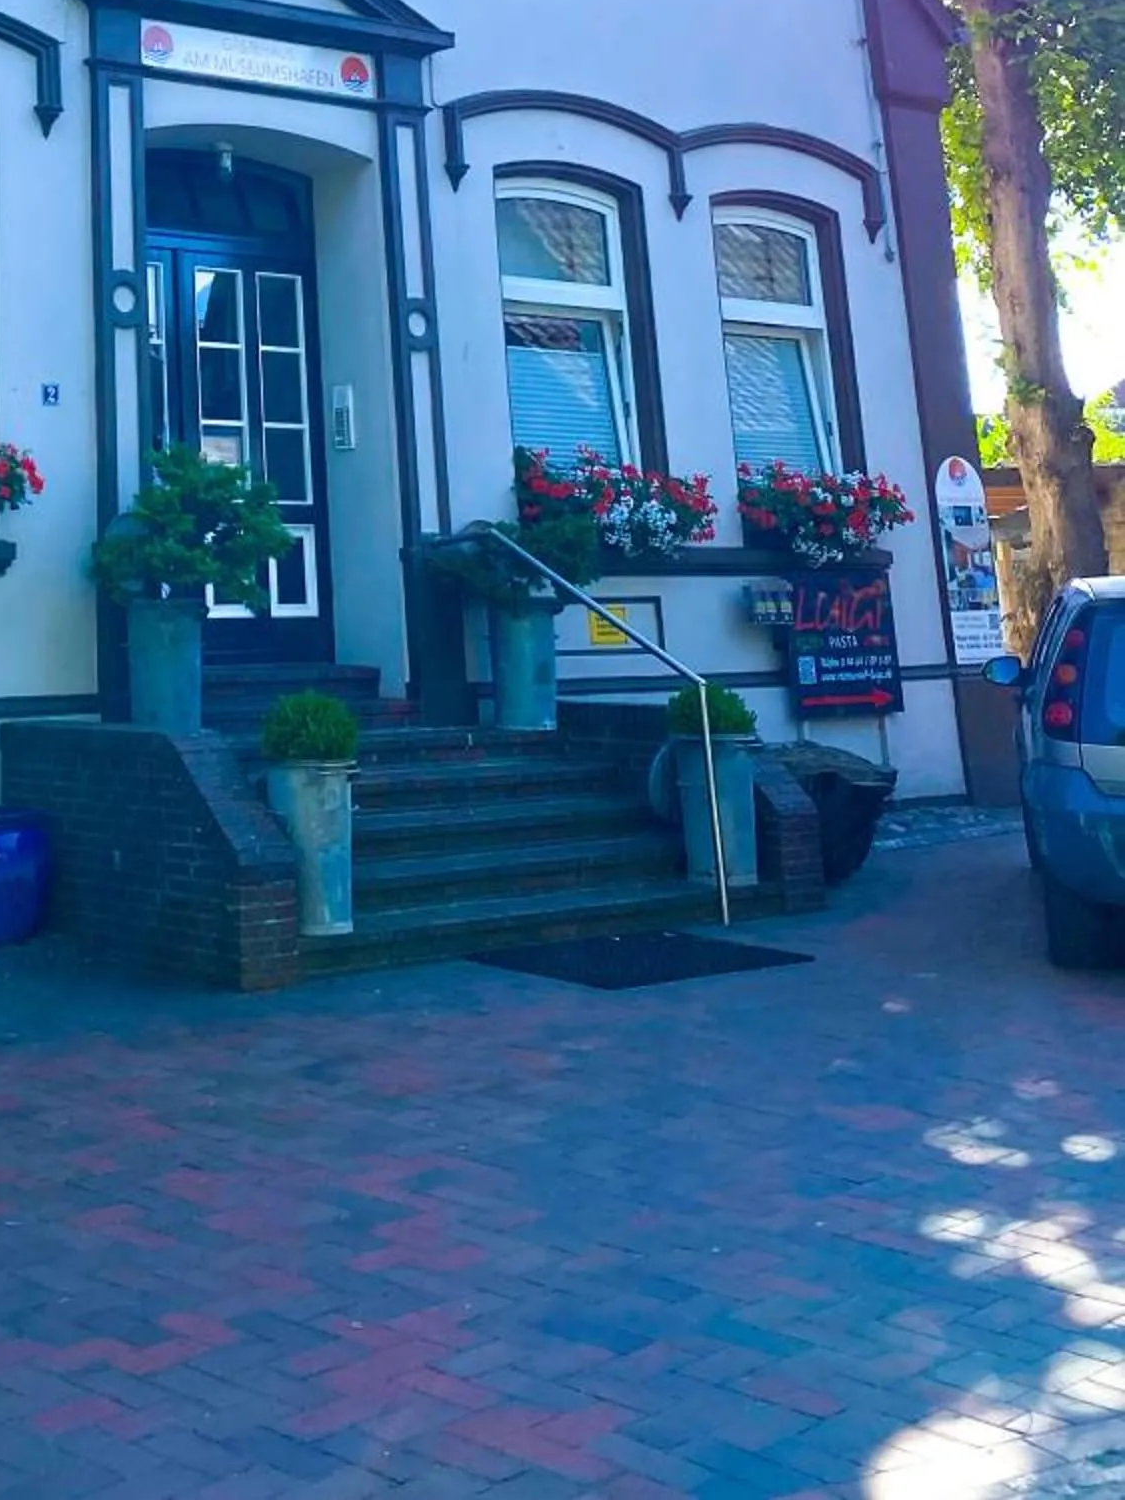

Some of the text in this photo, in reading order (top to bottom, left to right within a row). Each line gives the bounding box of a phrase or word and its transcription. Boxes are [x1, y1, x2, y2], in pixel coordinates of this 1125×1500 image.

[183, 49, 335, 87] AM MUSEUMSHAFEN
[46, 386, 57, 403] 2
[828, 635, 859, 649] PASTA
